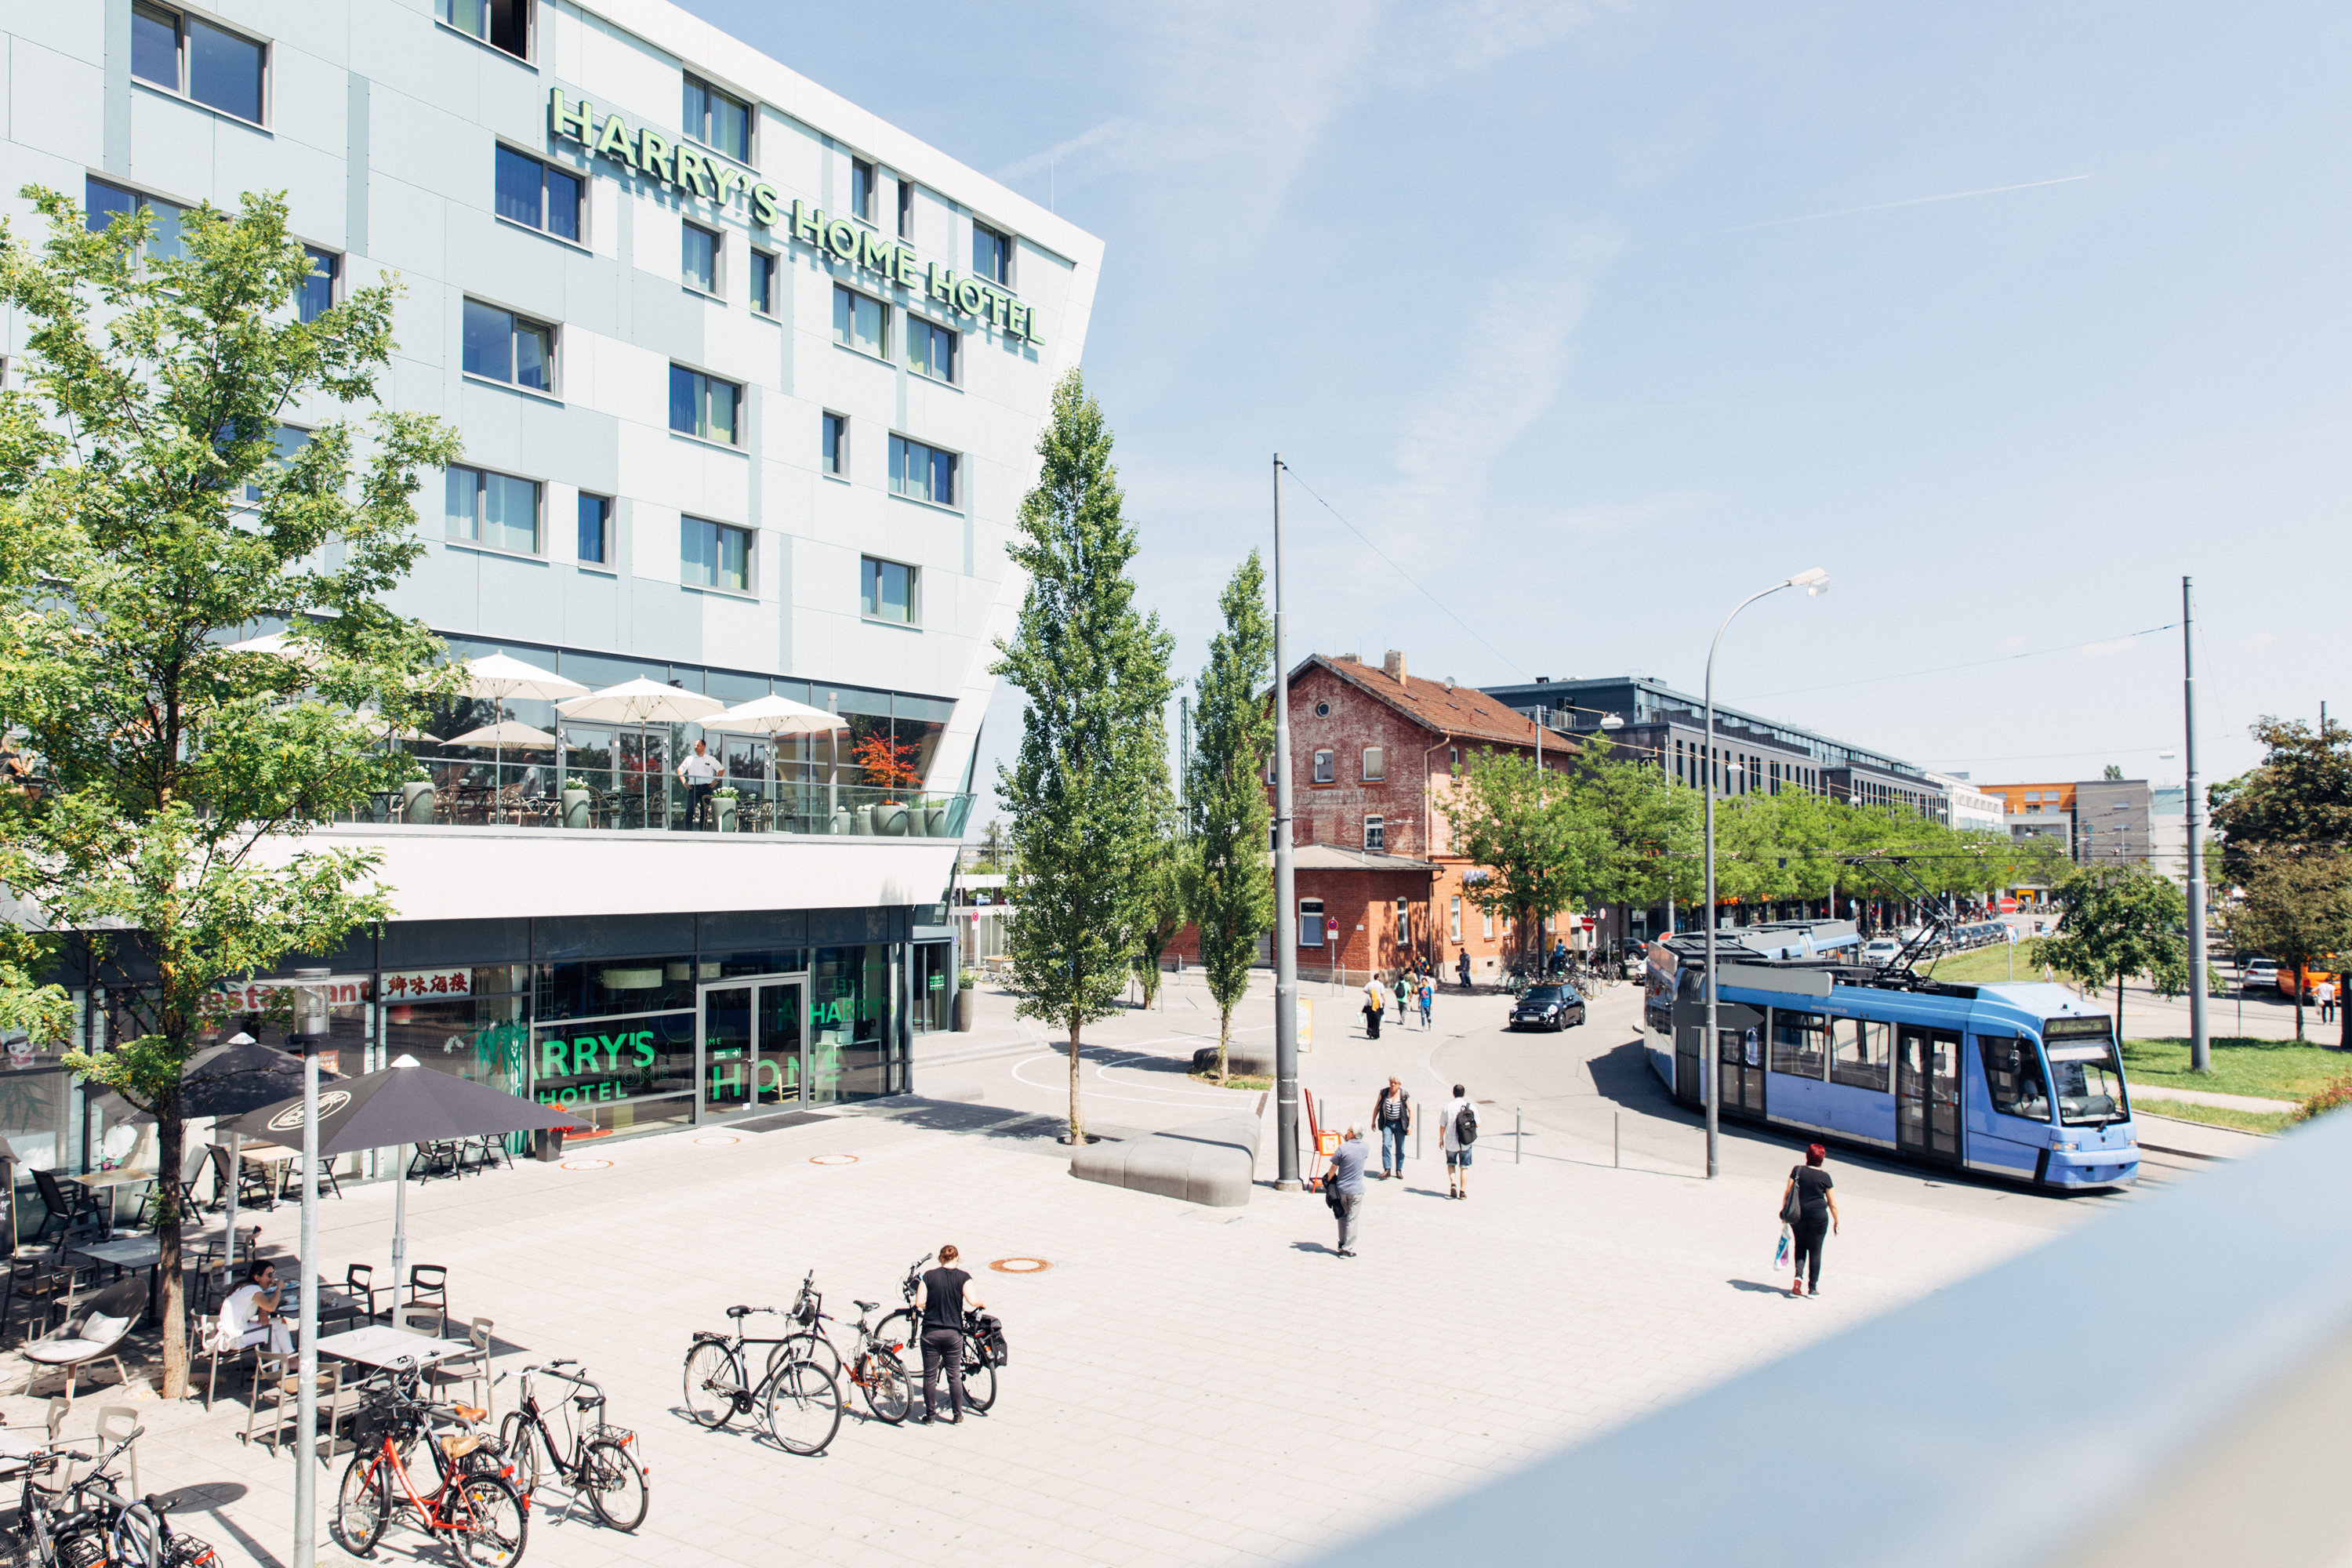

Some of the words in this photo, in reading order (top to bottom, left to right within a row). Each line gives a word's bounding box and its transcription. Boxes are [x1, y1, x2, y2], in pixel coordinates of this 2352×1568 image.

[550, 87, 779, 227] HARRY'S
[793, 199, 917, 289] HOME
[927, 262, 1046, 346] HOTEL
[534, 1030, 655, 1080] RRY'S
[539, 1080, 628, 1107] HOTEL
[603, 1064, 670, 1088] HOME
